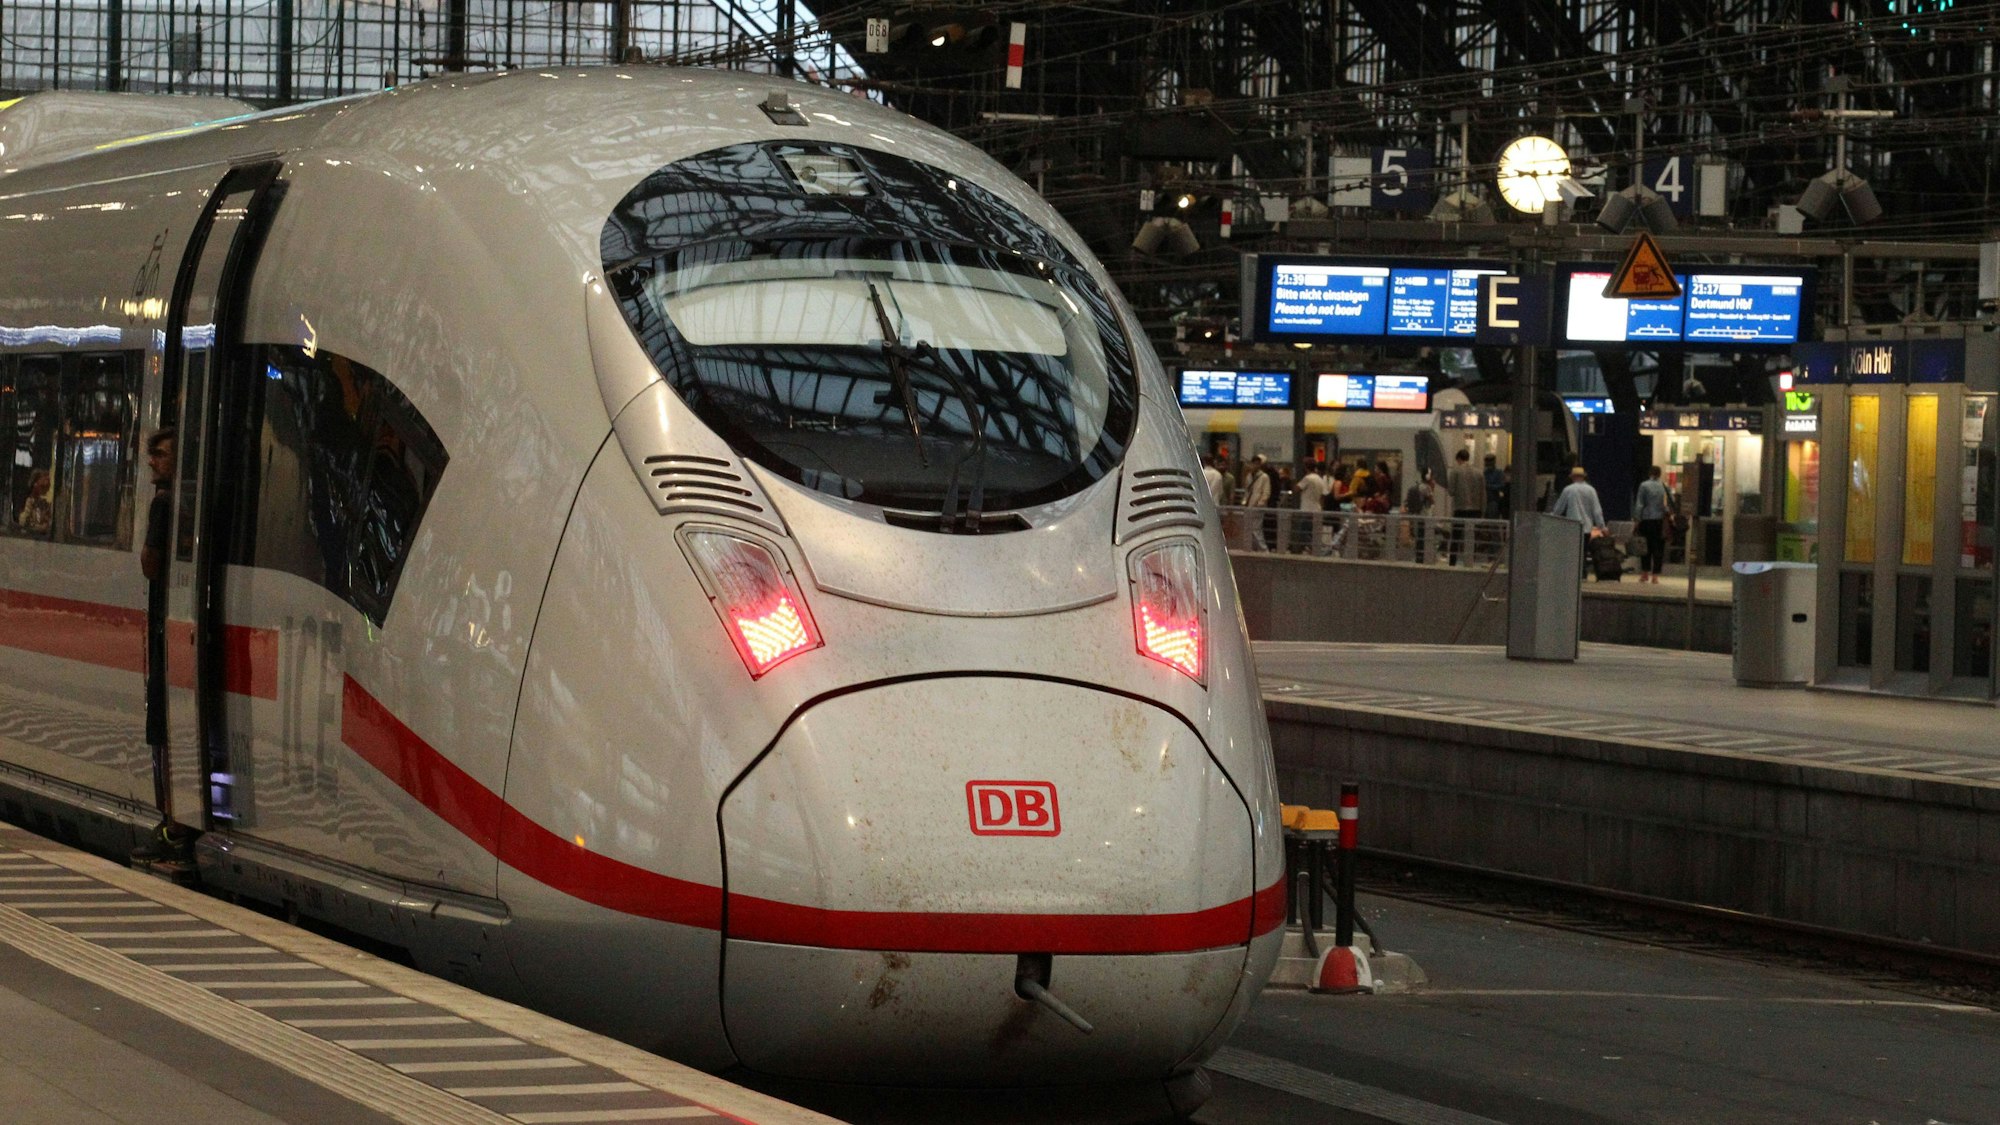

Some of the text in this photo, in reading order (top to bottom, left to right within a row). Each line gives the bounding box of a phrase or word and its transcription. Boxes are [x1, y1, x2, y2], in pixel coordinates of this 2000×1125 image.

[869, 24, 887, 37] 068
[1379, 149, 1408, 196] 5
[1655, 156, 1685, 202] 4
[1277, 274, 1304, 286] 21:39
[1452, 278, 1470, 287] 22:12
[1276, 287, 1369, 304] Bitte nicht einsteigen
[1692, 283, 1719, 295] 21:17
[1274, 302, 1362, 316] Please do not board
[1488, 276, 1520, 328] E
[1690, 296, 1735, 310] Dortmund
[1735, 297, 1753, 310] Hbf
[1850, 346, 1892, 374] Köln Hbf
[978, 789, 1050, 827] DB
